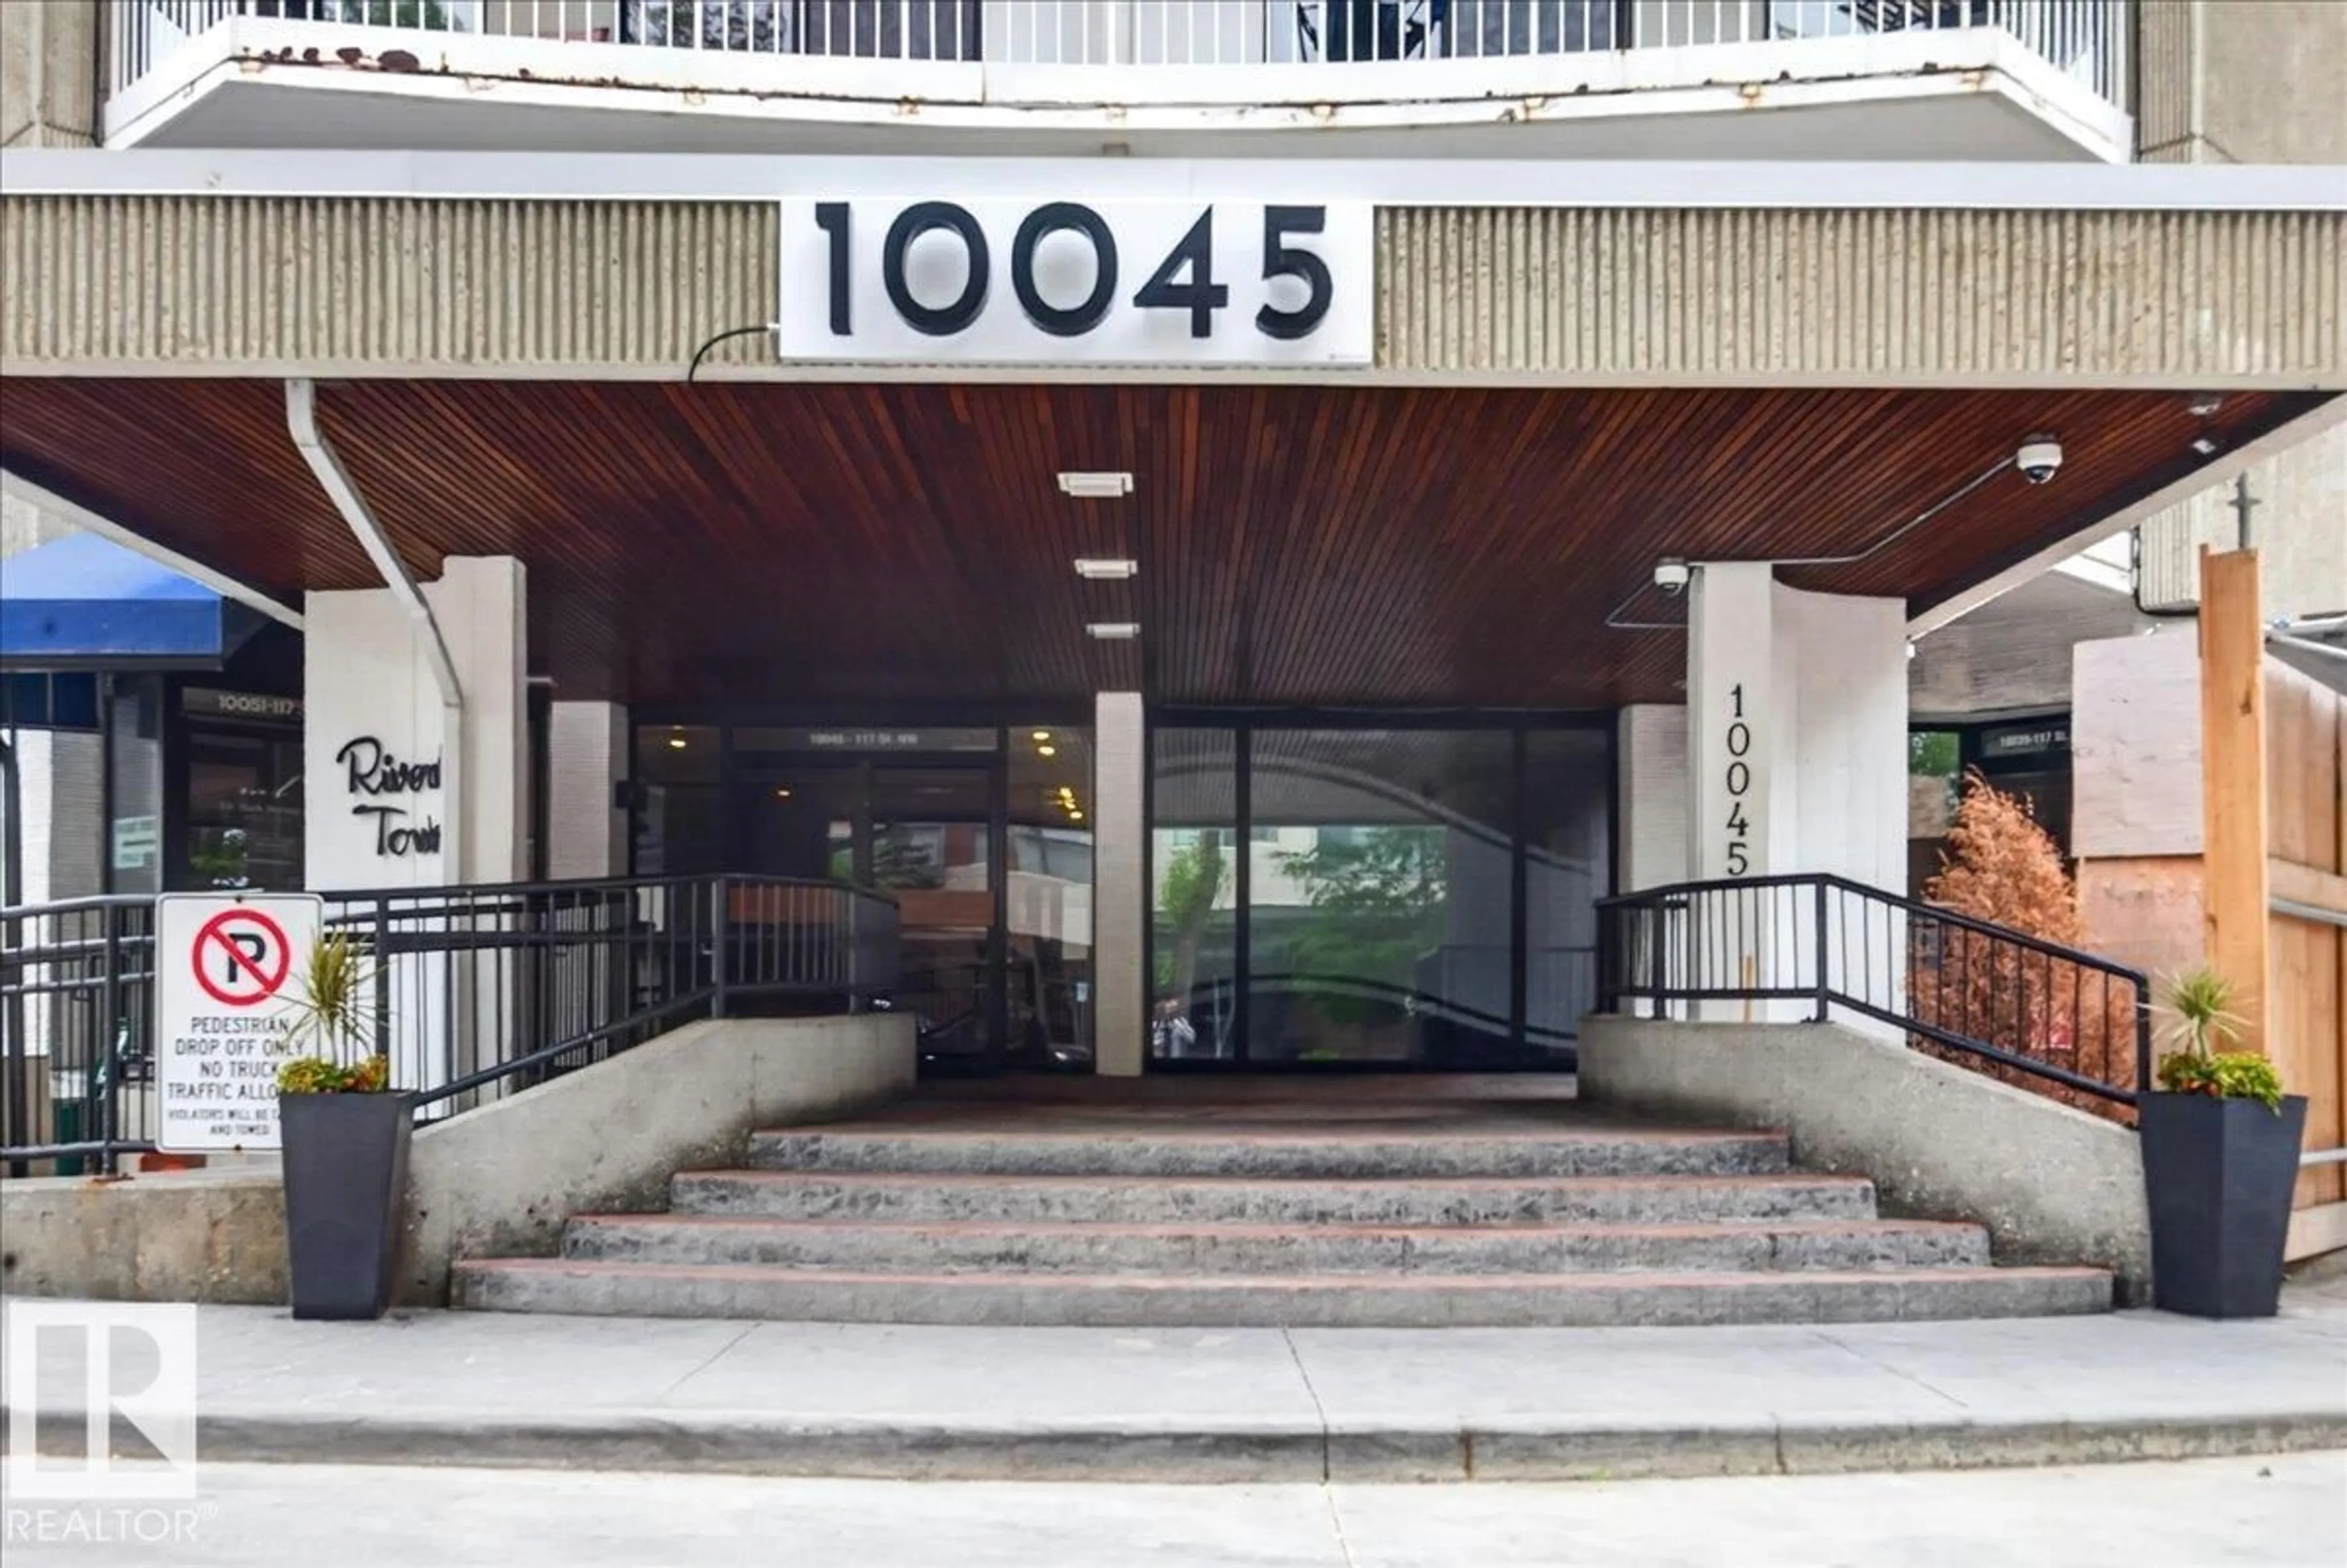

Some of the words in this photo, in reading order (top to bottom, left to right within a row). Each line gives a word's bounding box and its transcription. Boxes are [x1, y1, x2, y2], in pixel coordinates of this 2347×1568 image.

[815, 201, 1334, 340] 10045
[1727, 683, 1750, 876] 10045
[191, 1017, 289, 1035] PEDESTRIAN
[175, 1038, 219, 1055] DROP
[226, 1038, 257, 1055] OFF
[262, 1038, 304, 1055] ONLY
[200, 1061, 222, 1077] NO
[169, 1083, 232, 1099] TRAFFIC
